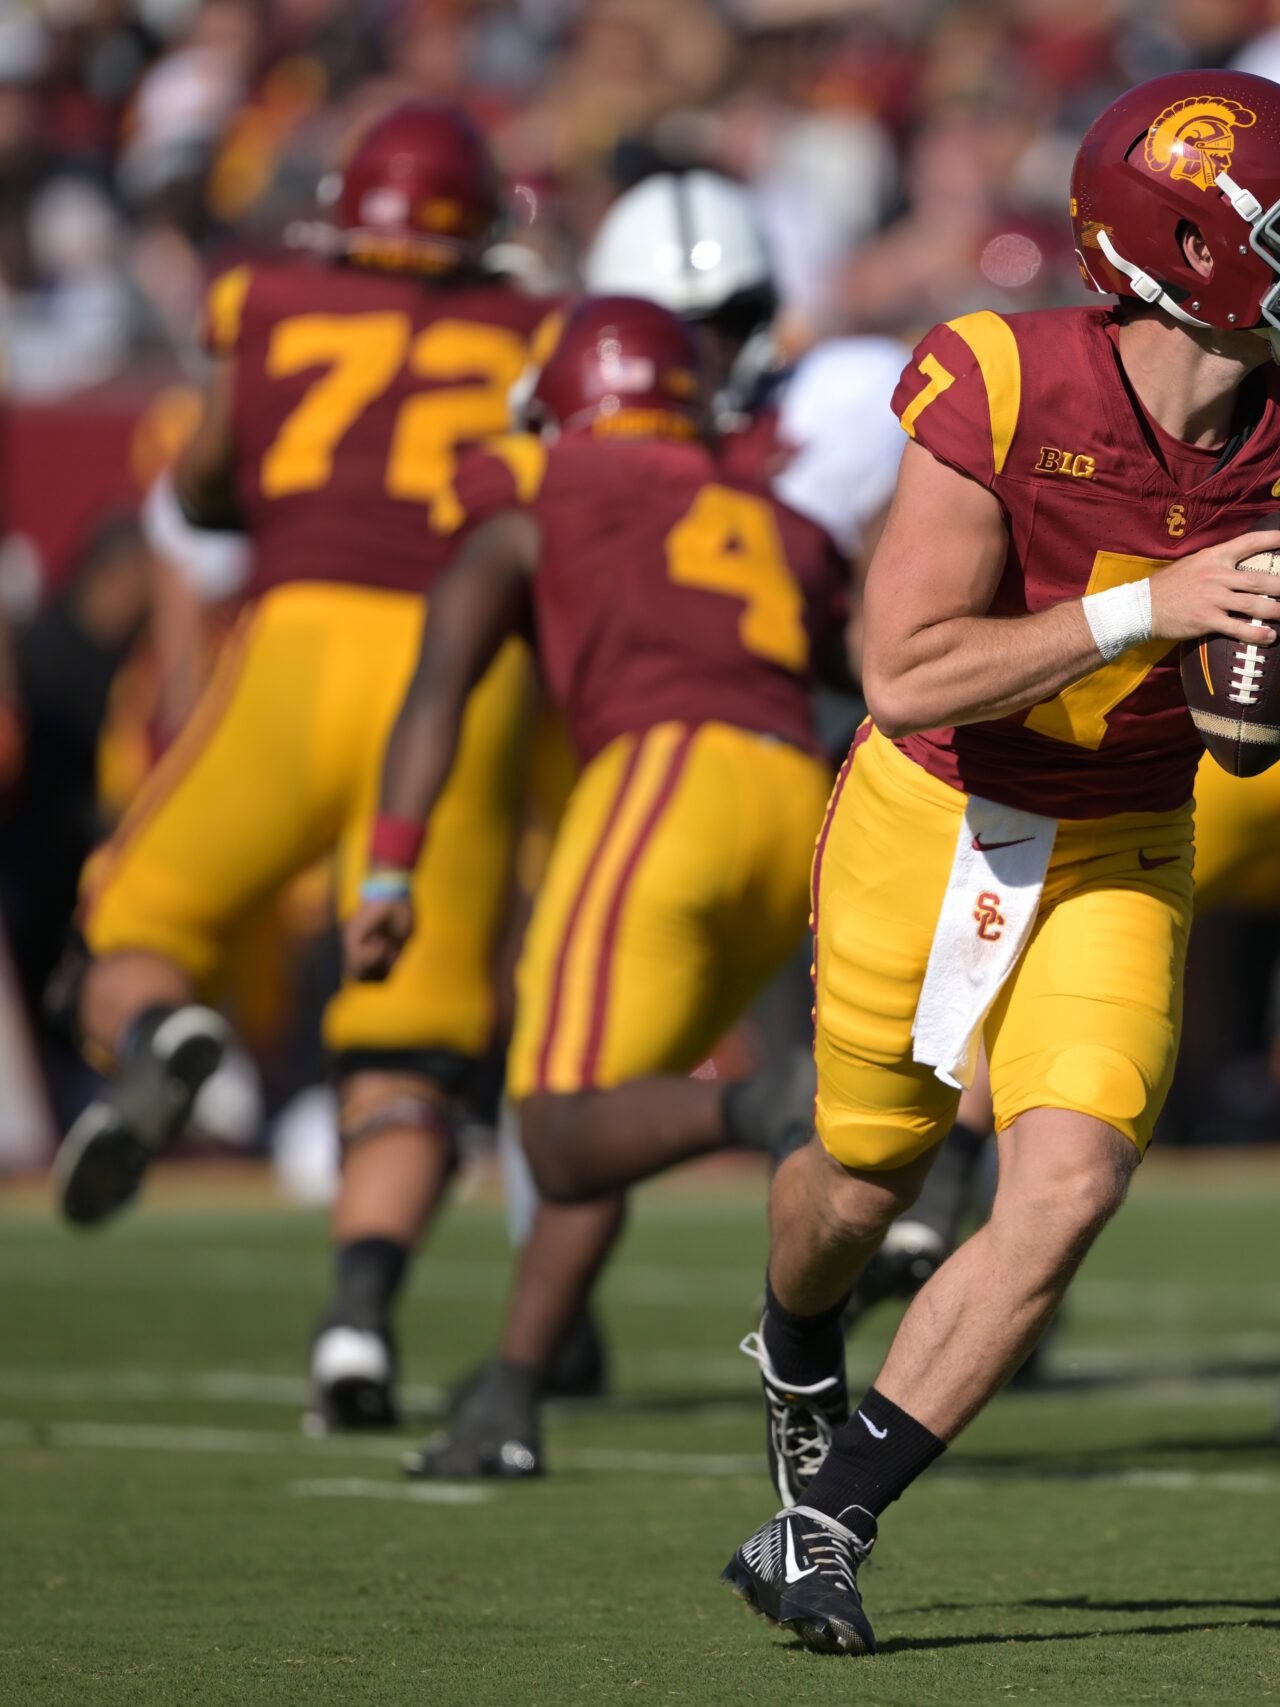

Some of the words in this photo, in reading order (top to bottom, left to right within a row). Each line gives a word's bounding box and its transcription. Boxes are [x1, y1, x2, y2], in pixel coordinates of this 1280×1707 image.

[262, 310, 529, 504] 72
[900, 353, 956, 438] 7
[666, 479, 810, 672] 4
[1166, 504, 1186, 537] SC
[1023, 550, 1180, 751] 7
[974, 891, 1005, 942] SC
